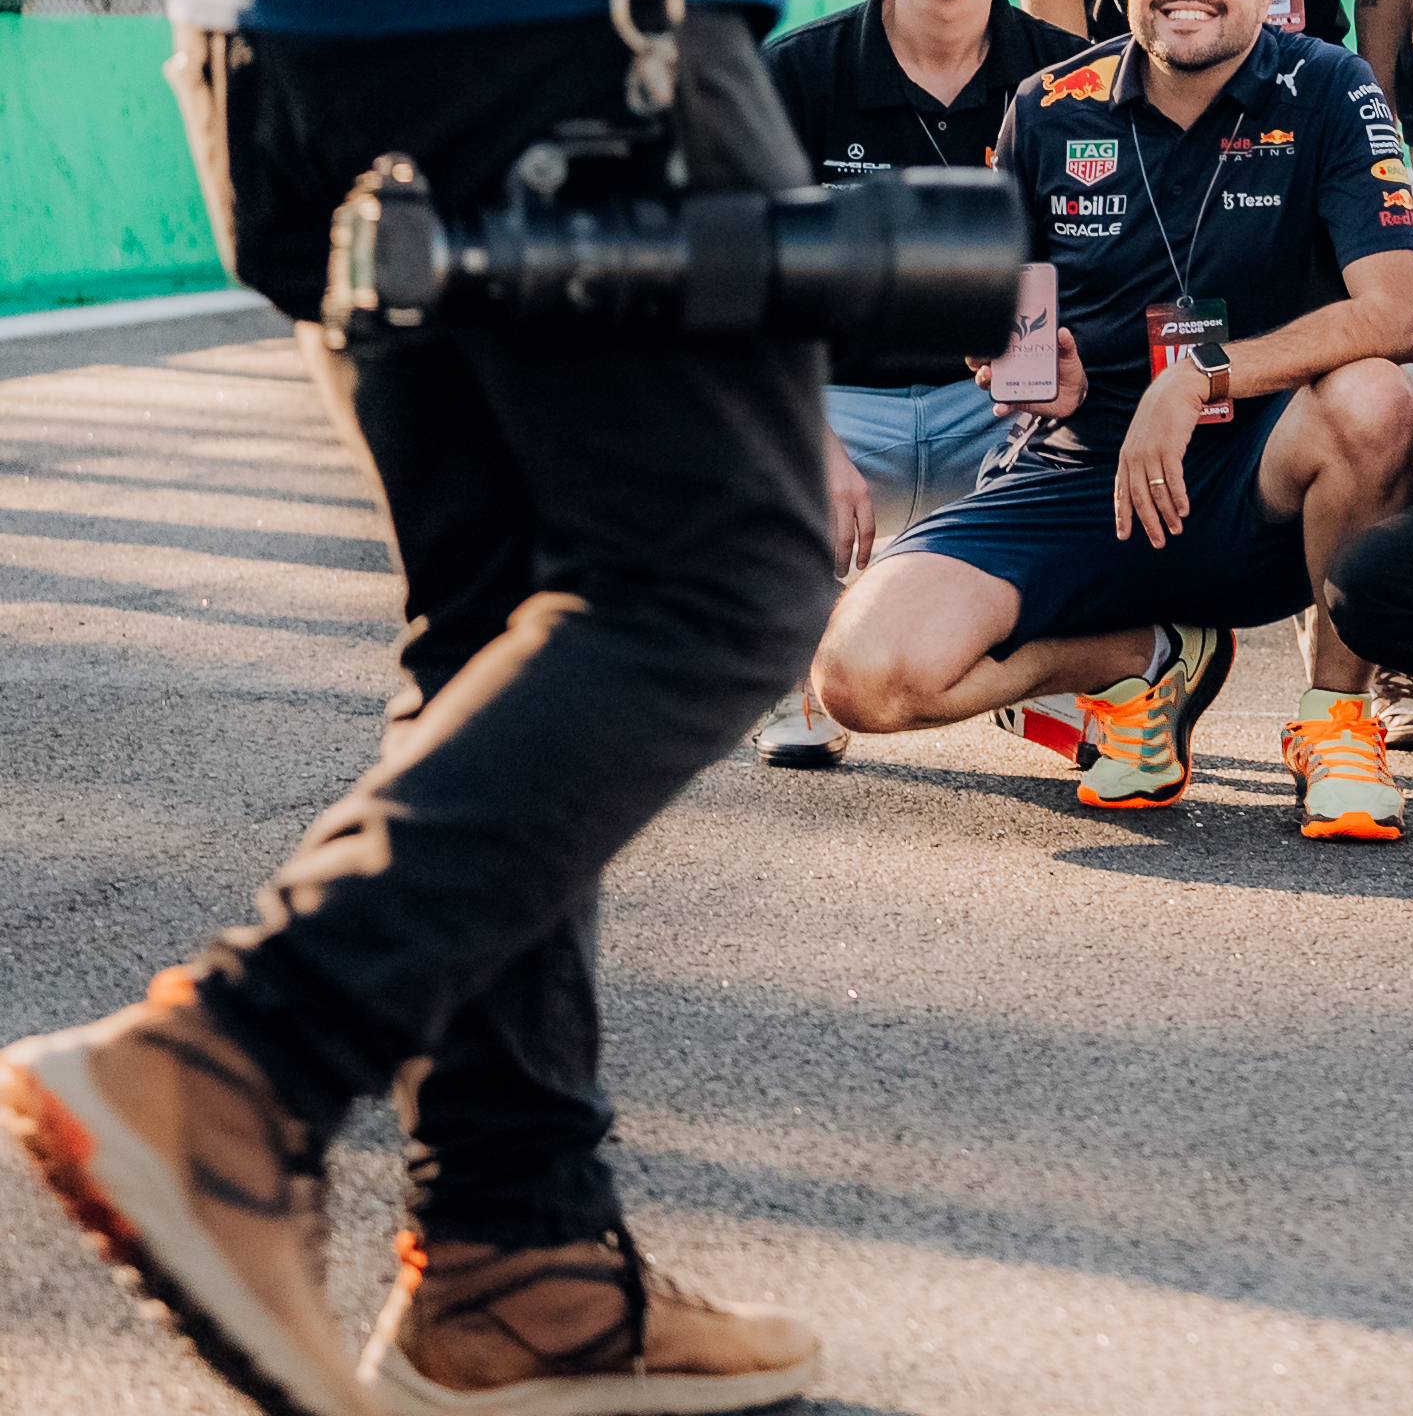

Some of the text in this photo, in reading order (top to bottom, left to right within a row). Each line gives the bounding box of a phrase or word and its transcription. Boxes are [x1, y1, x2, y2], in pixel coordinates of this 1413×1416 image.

[1071, 144, 1114, 158] TAG
[1069, 161, 1114, 182] HEUER
[1051, 194, 1104, 216] Mobil
[1236, 192, 1282, 208] Tezos
[1054, 221, 1122, 237] ORACLE
